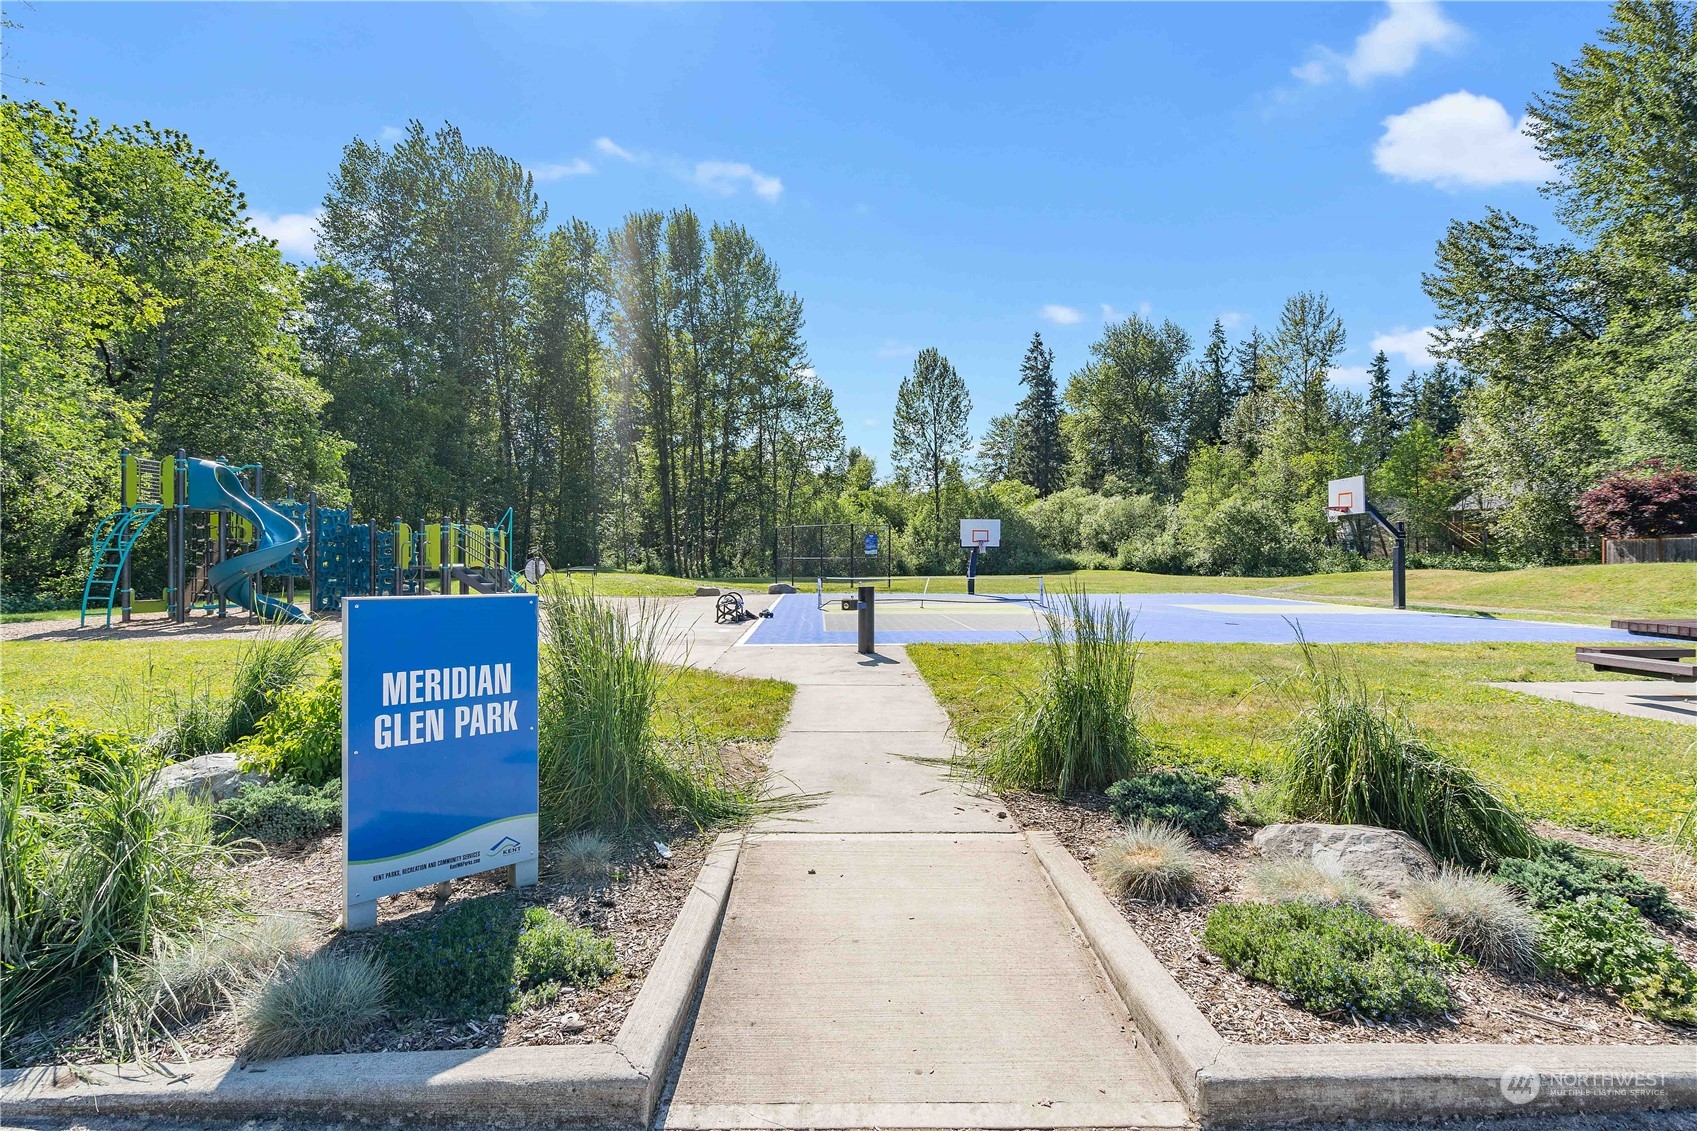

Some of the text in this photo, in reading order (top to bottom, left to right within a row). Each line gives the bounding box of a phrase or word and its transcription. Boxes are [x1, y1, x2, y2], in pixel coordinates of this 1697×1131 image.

[382, 662, 512, 706] MERIDIAN
[374, 700, 519, 750] GLEN PARK
[373, 851, 480, 882] KENT PARKS, RECREATION AND COMMUNITY SERVICES
[502, 846, 521, 855] KENT
